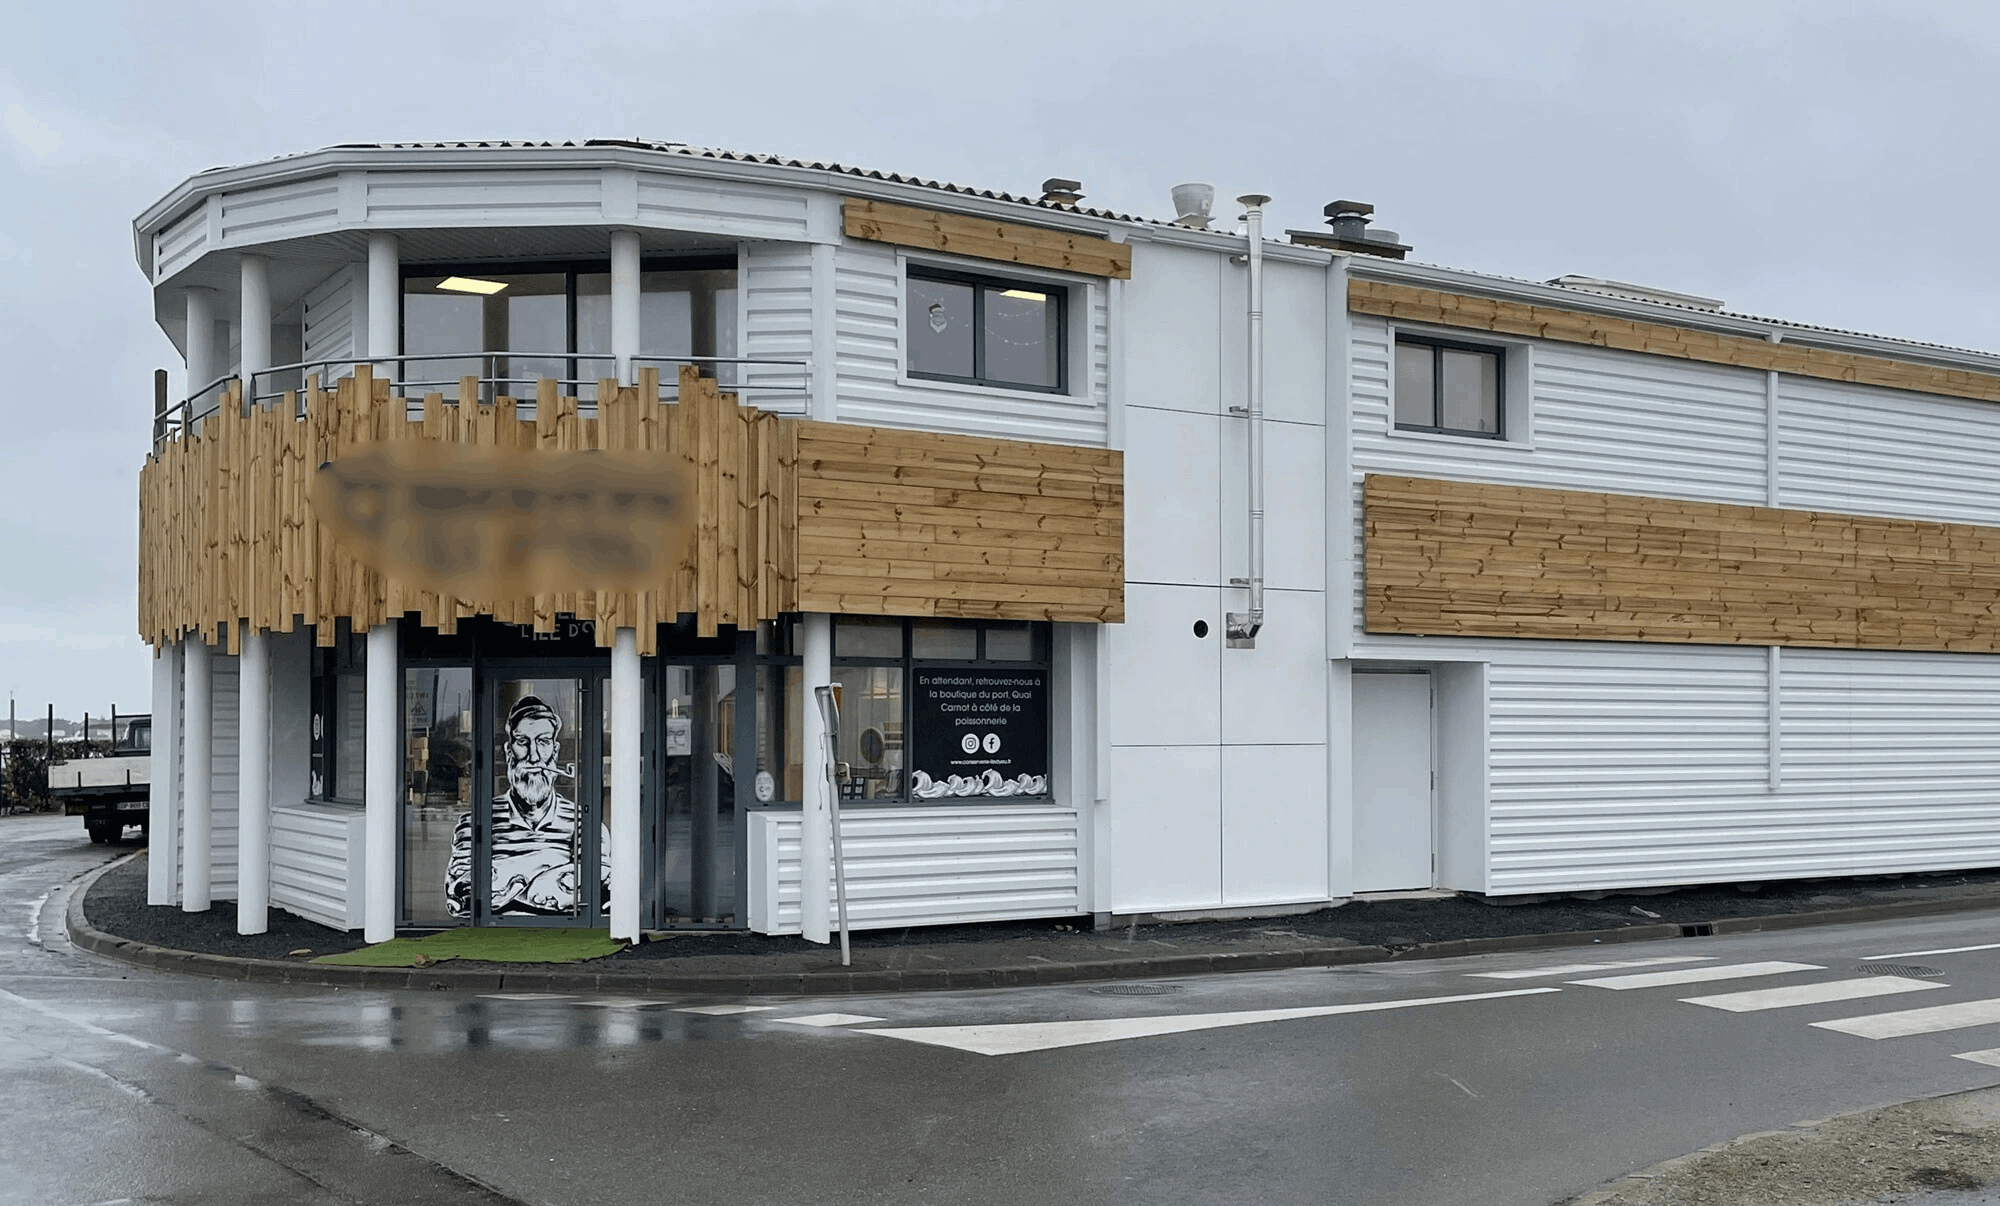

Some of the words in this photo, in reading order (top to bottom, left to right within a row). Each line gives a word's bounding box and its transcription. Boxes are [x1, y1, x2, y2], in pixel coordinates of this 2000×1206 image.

[920, 676, 929, 685] En
[932, 676, 974, 686] attendant,
[976, 677, 1033, 686] retrouvez-nous
[1035, 677, 1041, 686] à
[929, 690, 937, 698] la
[940, 690, 977, 700] boutique
[979, 690, 990, 699] du
[1012, 690, 1032, 699] Quai
[941, 703, 969, 712] Carnot
[971, 703, 977, 712] à
[980, 703, 998, 712] côté
[1000, 703, 1011, 712] de
[1013, 704, 1021, 712] la
[955, 717, 1007, 727] poissonnerie
